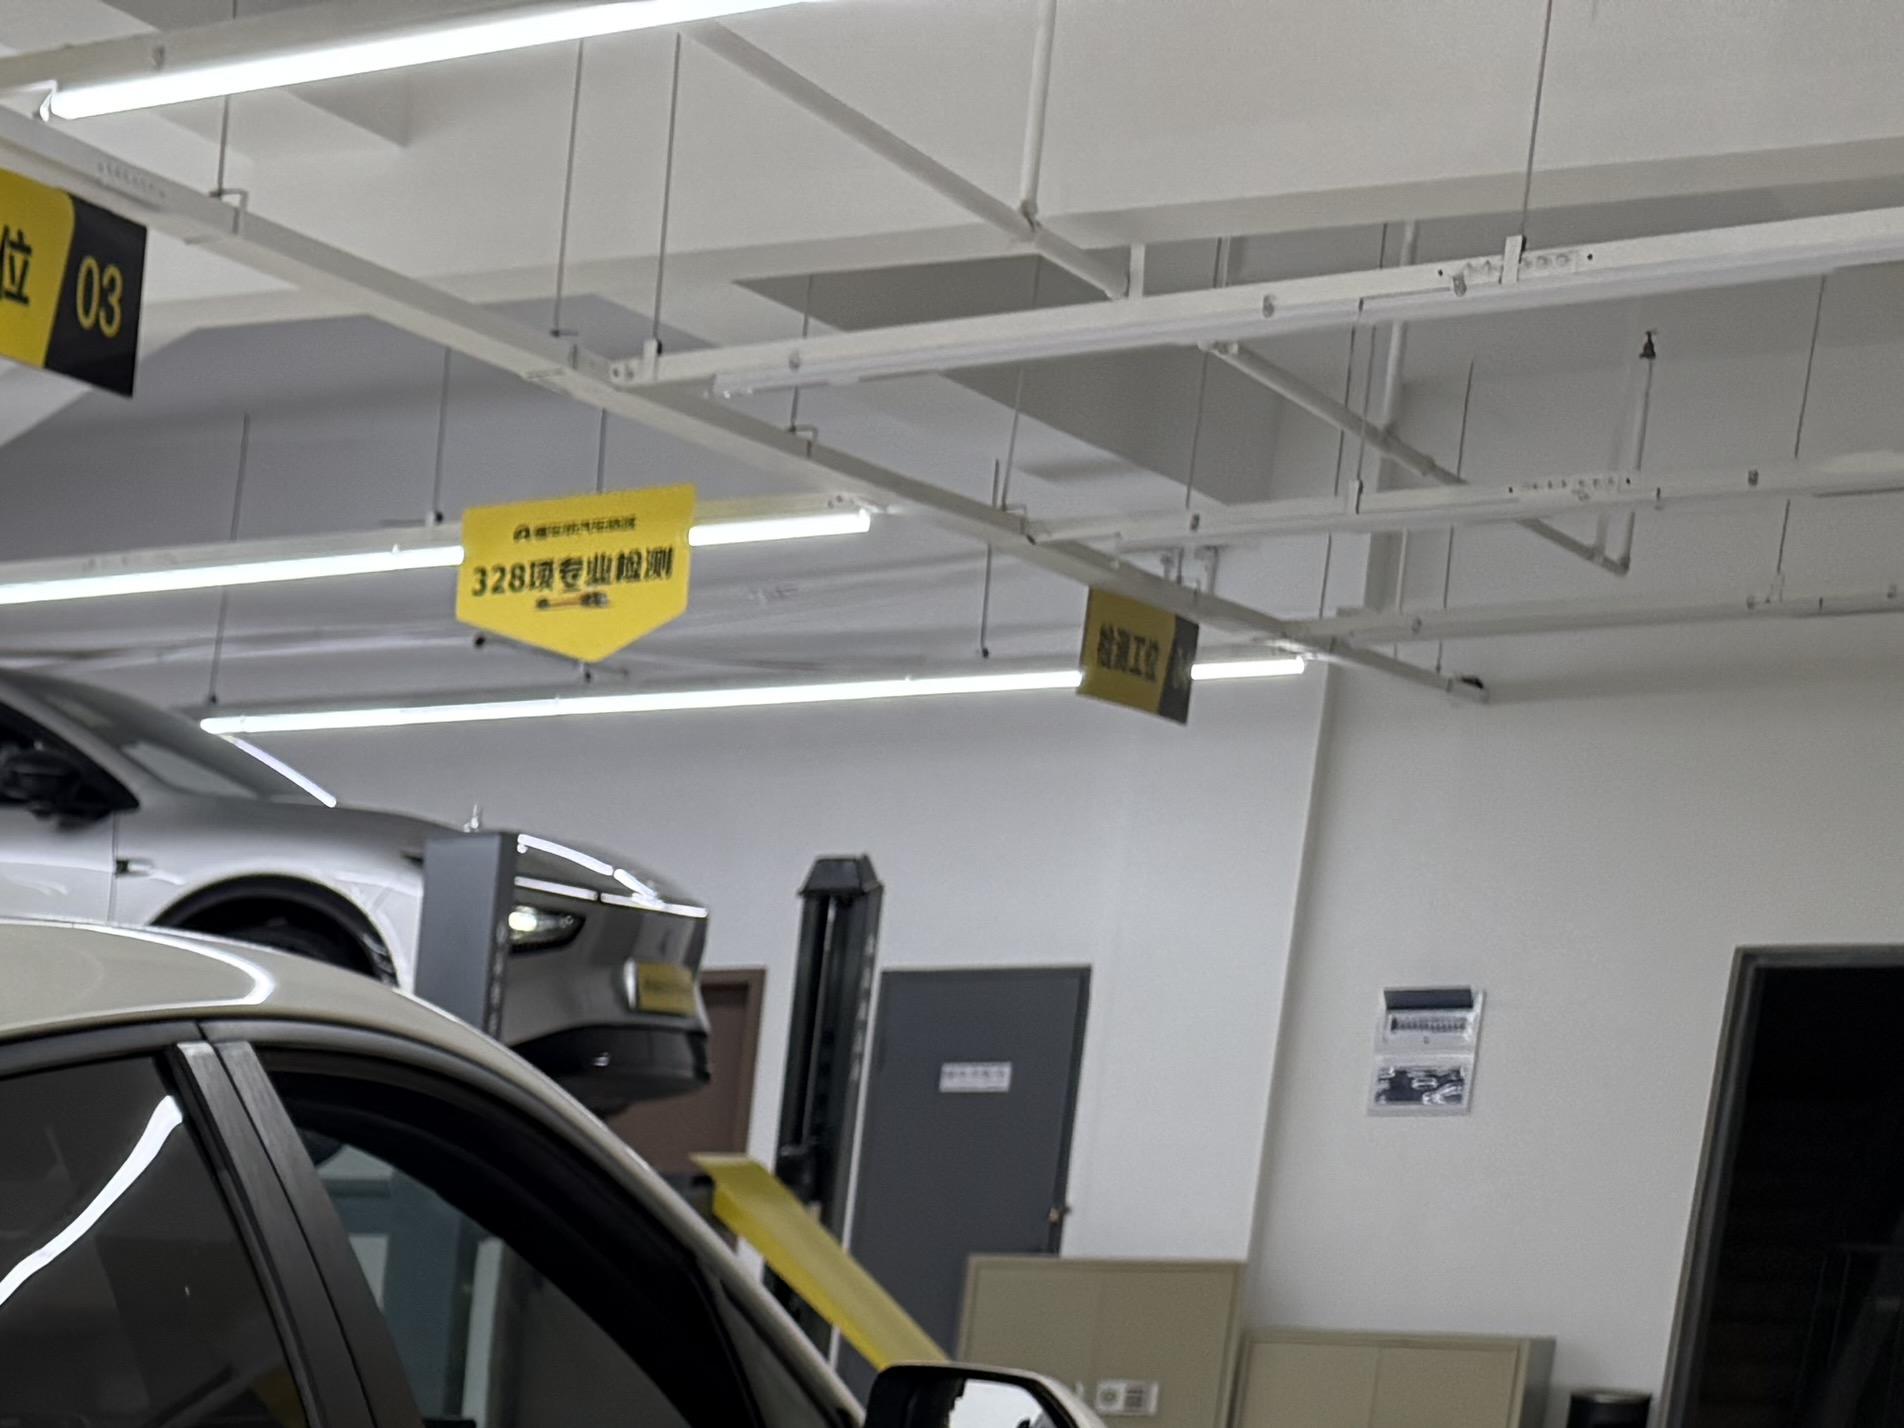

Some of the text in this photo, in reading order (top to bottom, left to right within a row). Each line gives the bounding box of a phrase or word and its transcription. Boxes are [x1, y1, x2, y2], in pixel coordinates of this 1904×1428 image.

[76, 255, 123, 338] 03
[471, 546, 674, 597] 328项专业检测
